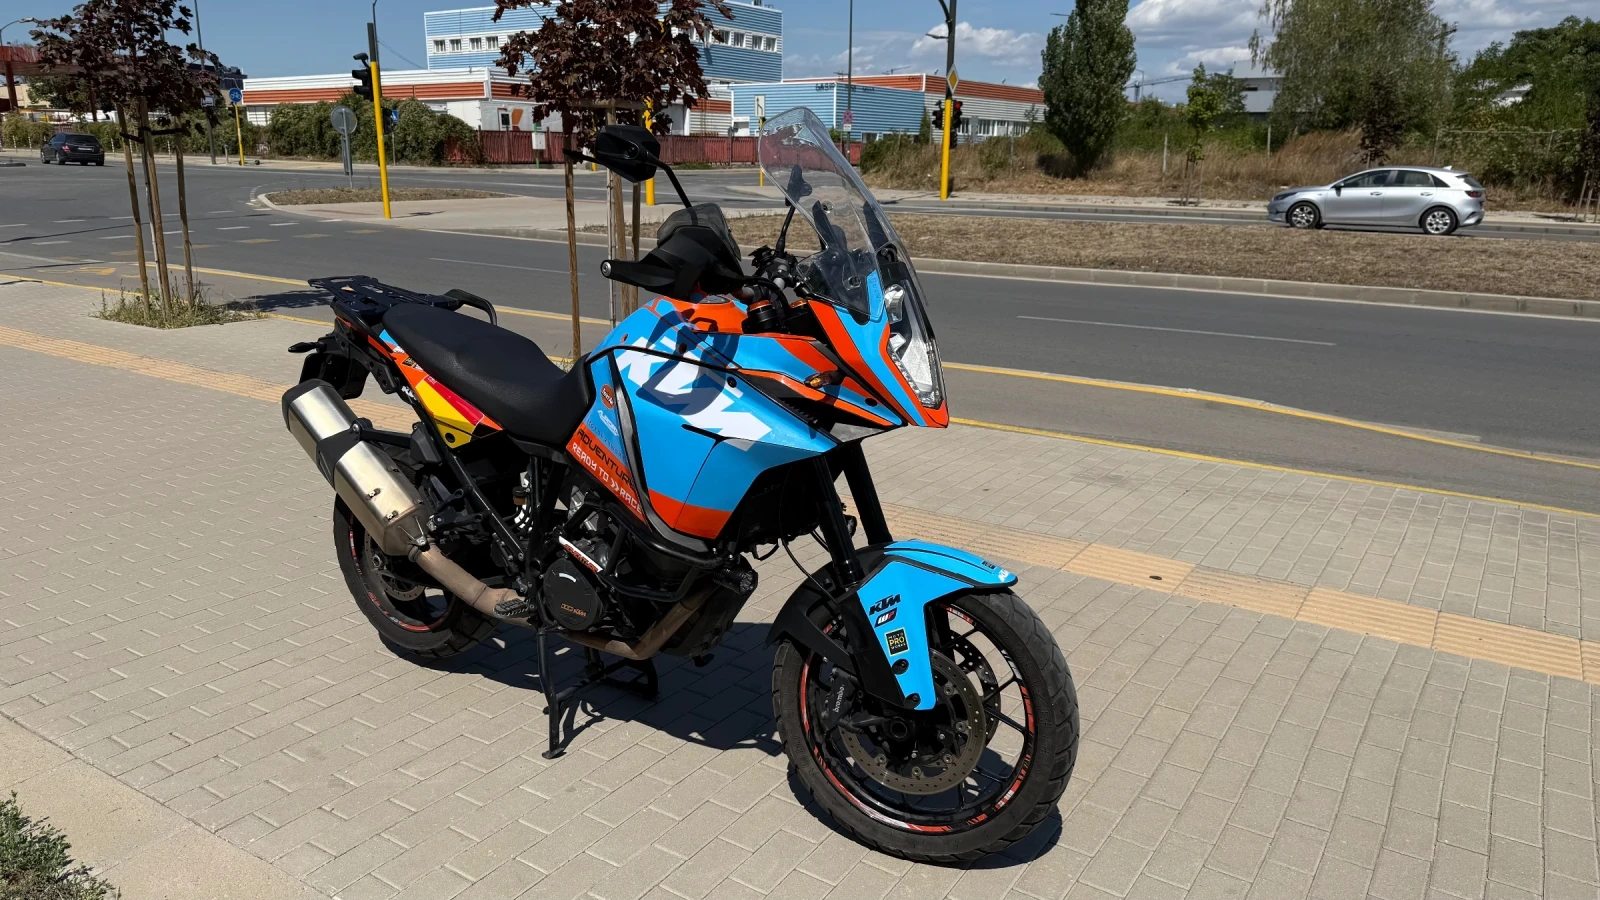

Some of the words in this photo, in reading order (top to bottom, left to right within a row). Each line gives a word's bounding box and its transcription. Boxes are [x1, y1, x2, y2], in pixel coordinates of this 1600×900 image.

[615, 336, 773, 452] KTM
[572, 442, 597, 471] READY
[599, 467, 610, 482] TO
[869, 594, 901, 615] KTM
[889, 636, 905, 647] PRO
[832, 686, 845, 713] brembo
